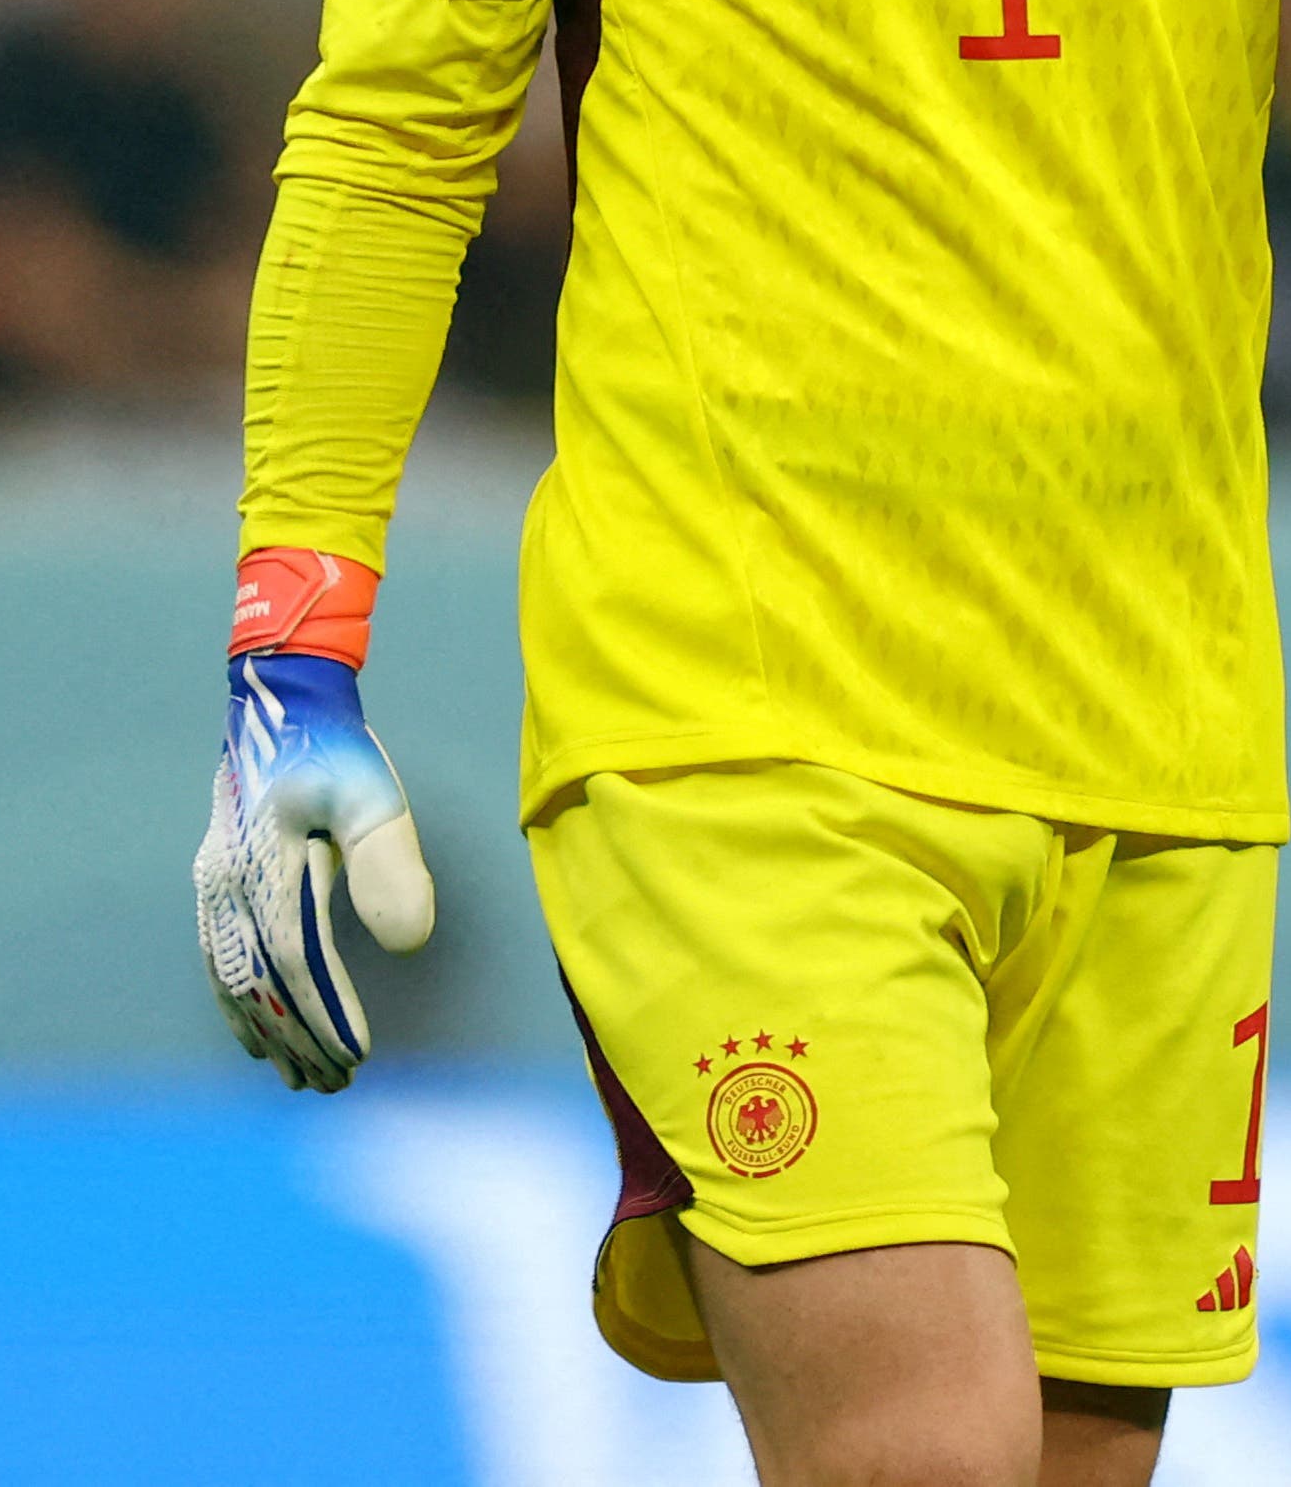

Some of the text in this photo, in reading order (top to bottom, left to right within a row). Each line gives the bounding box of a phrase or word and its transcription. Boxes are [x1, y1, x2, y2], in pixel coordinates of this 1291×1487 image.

[725, 1077, 787, 1105] DEUTSCHER
[1209, 1000, 1268, 1205] 1
[727, 1124, 800, 1163] FUSSBALL-BUND
